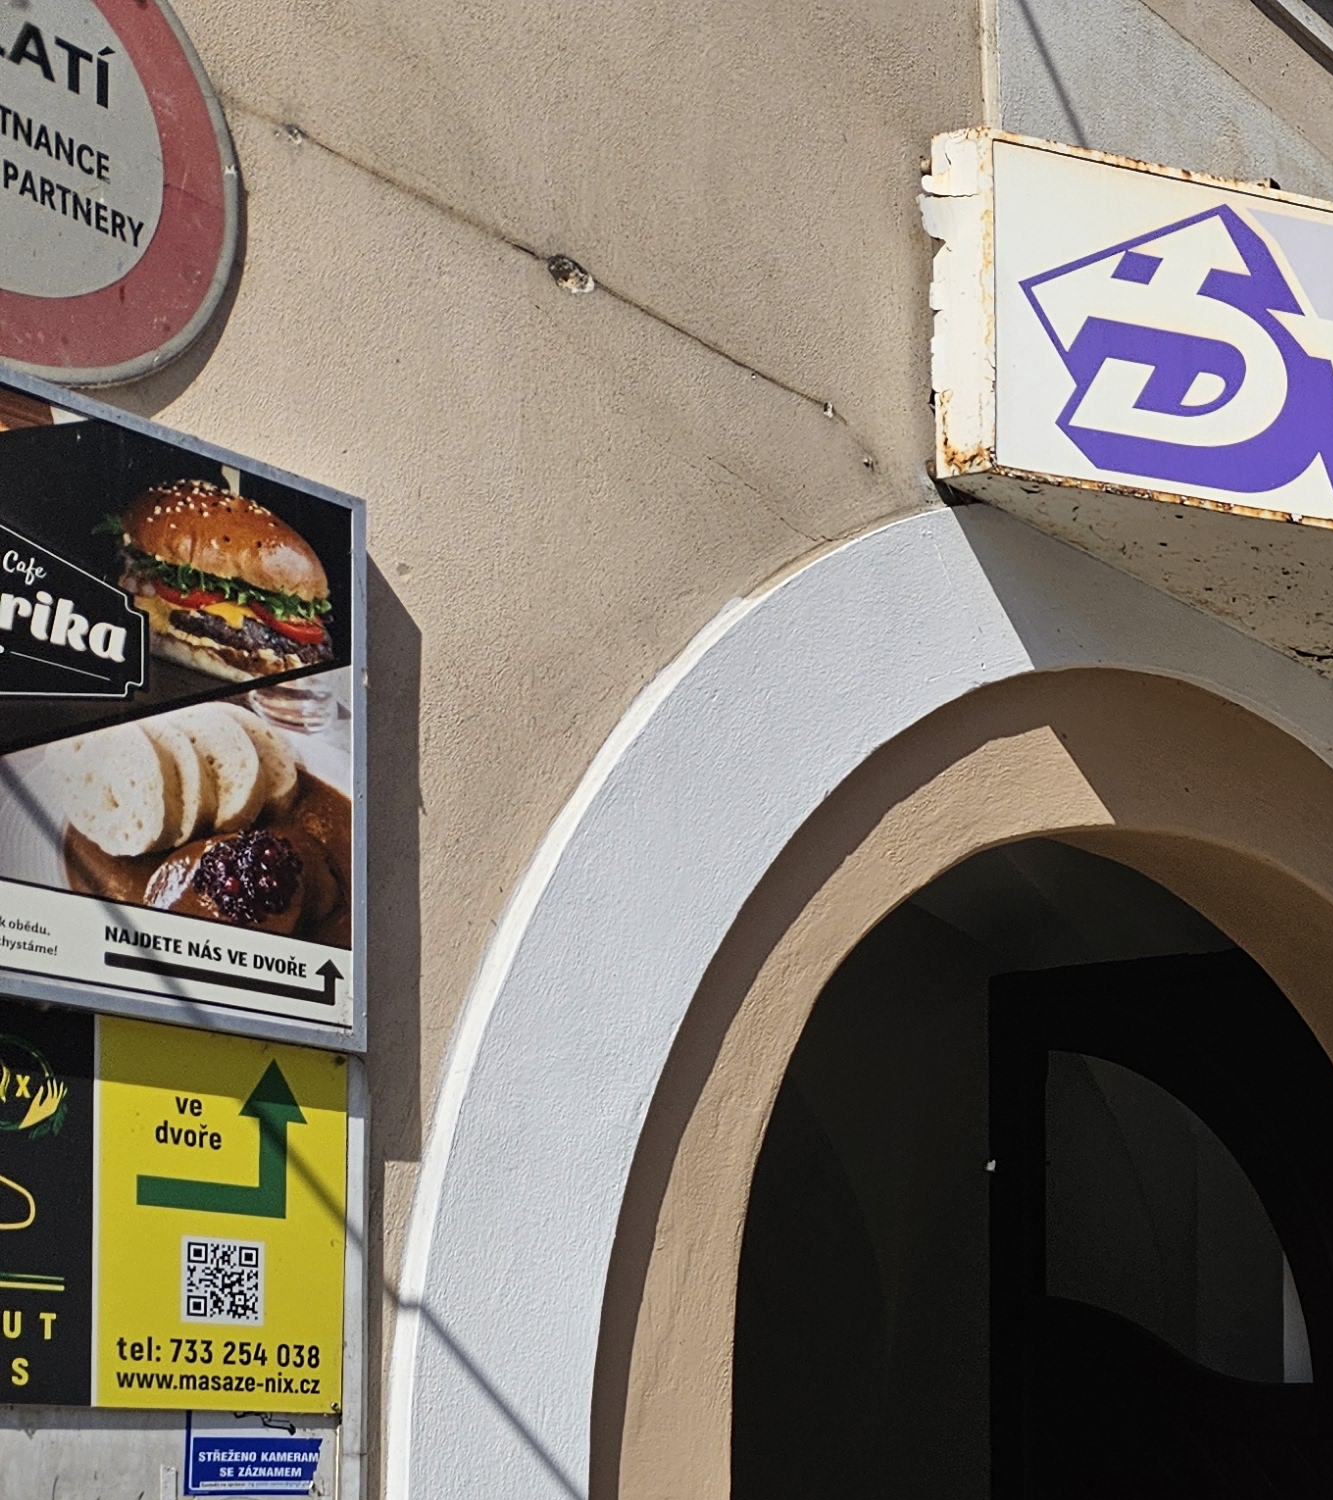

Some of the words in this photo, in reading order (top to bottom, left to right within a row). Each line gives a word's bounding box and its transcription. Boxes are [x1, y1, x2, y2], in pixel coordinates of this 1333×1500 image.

[0, 21, 116, 109] ATÍ
[0, 104, 111, 182] TNANCE
[3, 158, 145, 248] PARTNERY
[0, 590, 127, 663] rika
[8, 918, 51, 936] obědu.
[0, 935, 58, 956] hystáme!
[104, 925, 183, 955] NAJDETE
[187, 939, 223, 962] NÁS
[227, 949, 248, 967] VE
[253, 955, 308, 978] DVOŘE
[175, 1096, 203, 1117] ve
[155, 1120, 222, 1150] dvoře
[116, 1336, 161, 1362] tel:
[170, 1338, 213, 1364] 733
[222, 1341, 268, 1366] 254
[276, 1343, 321, 1369] 038
[116, 1371, 321, 1395] www.masaze-nix.cz
[198, 1448, 257, 1463] STŘEŽENO
[219, 1466, 235, 1477] SE
[238, 1464, 302, 1477] ZÁZNAMEM
